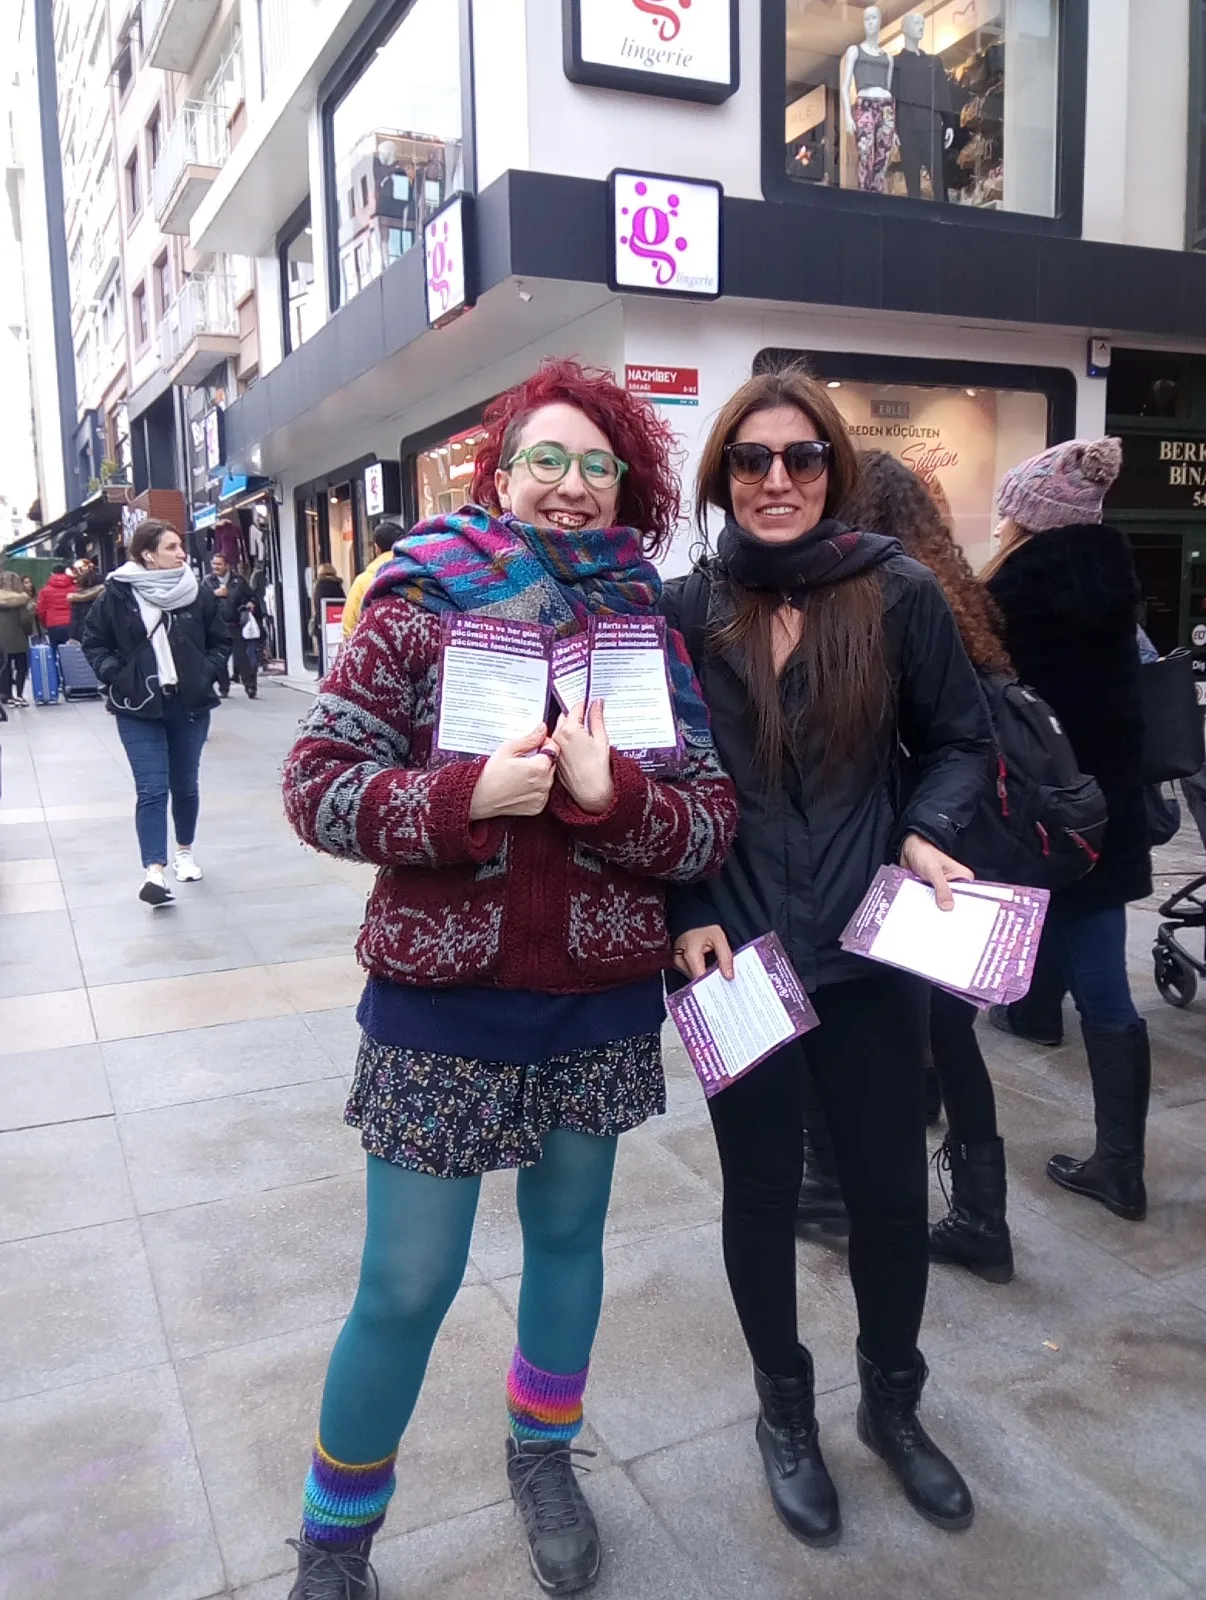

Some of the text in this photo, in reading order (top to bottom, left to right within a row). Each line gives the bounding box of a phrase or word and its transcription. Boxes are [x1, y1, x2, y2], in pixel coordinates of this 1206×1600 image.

[621, 37, 693, 68] lingerie
[675, 271, 714, 289] lingerie
[627, 368, 678, 384] NAZMİBEY
[885, 424, 940, 440] KÜÇÜLTEN
[451, 629, 488, 640] gücümüz
[451, 638, 489, 649] gücümüz
